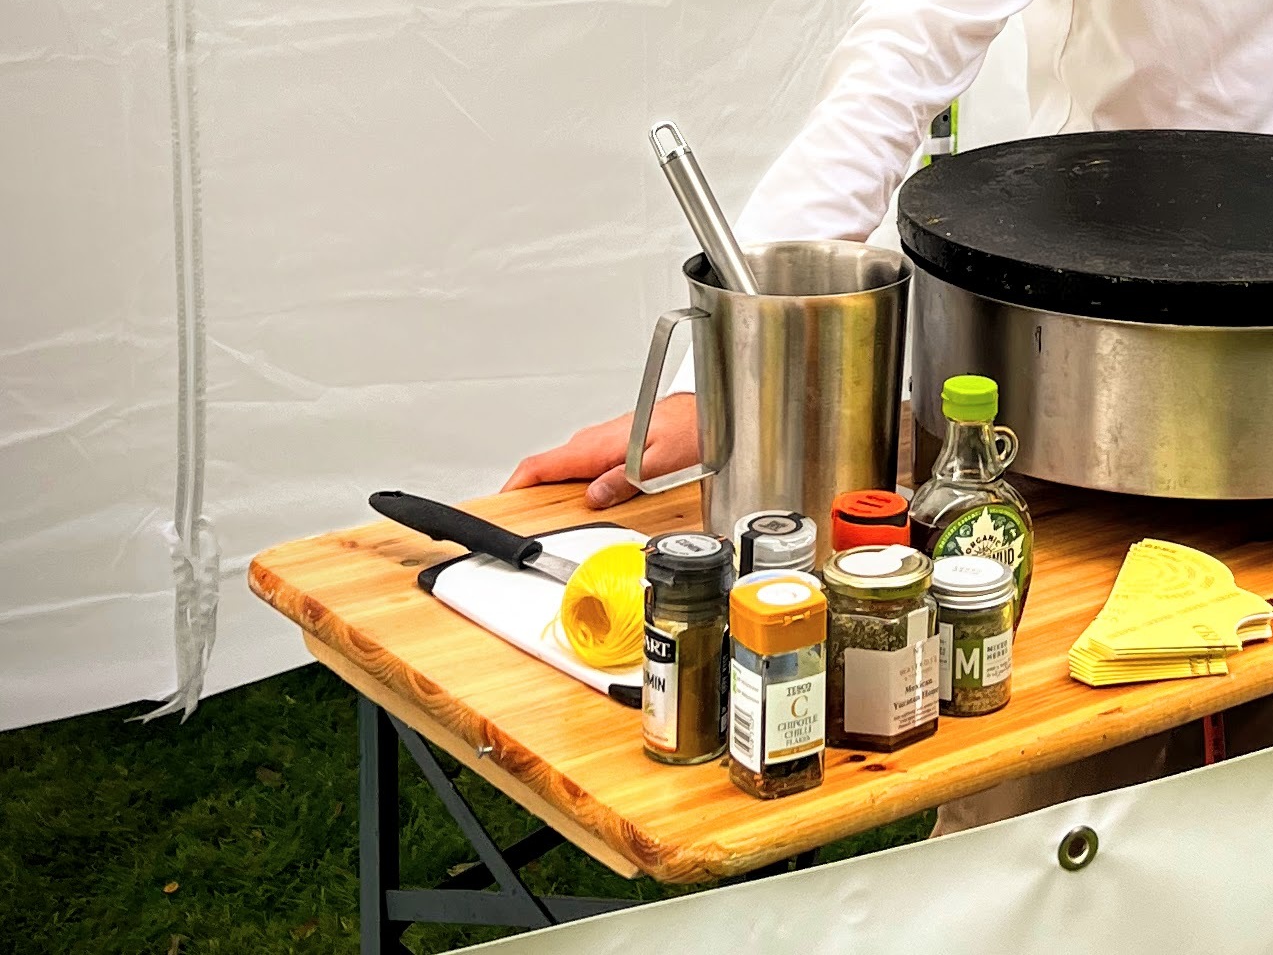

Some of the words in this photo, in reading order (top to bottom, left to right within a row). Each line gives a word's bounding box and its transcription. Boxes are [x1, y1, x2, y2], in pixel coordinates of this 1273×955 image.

[965, 534, 1001, 554] ORGANIC
[644, 634, 668, 657] ART
[955, 647, 980, 680] M
[644, 670, 666, 693] MIN
[786, 681, 812, 697] TESCO
[790, 694, 809, 719] C
[777, 713, 819, 732] CHIPOTLE
[783, 724, 812, 740] CHILLI
